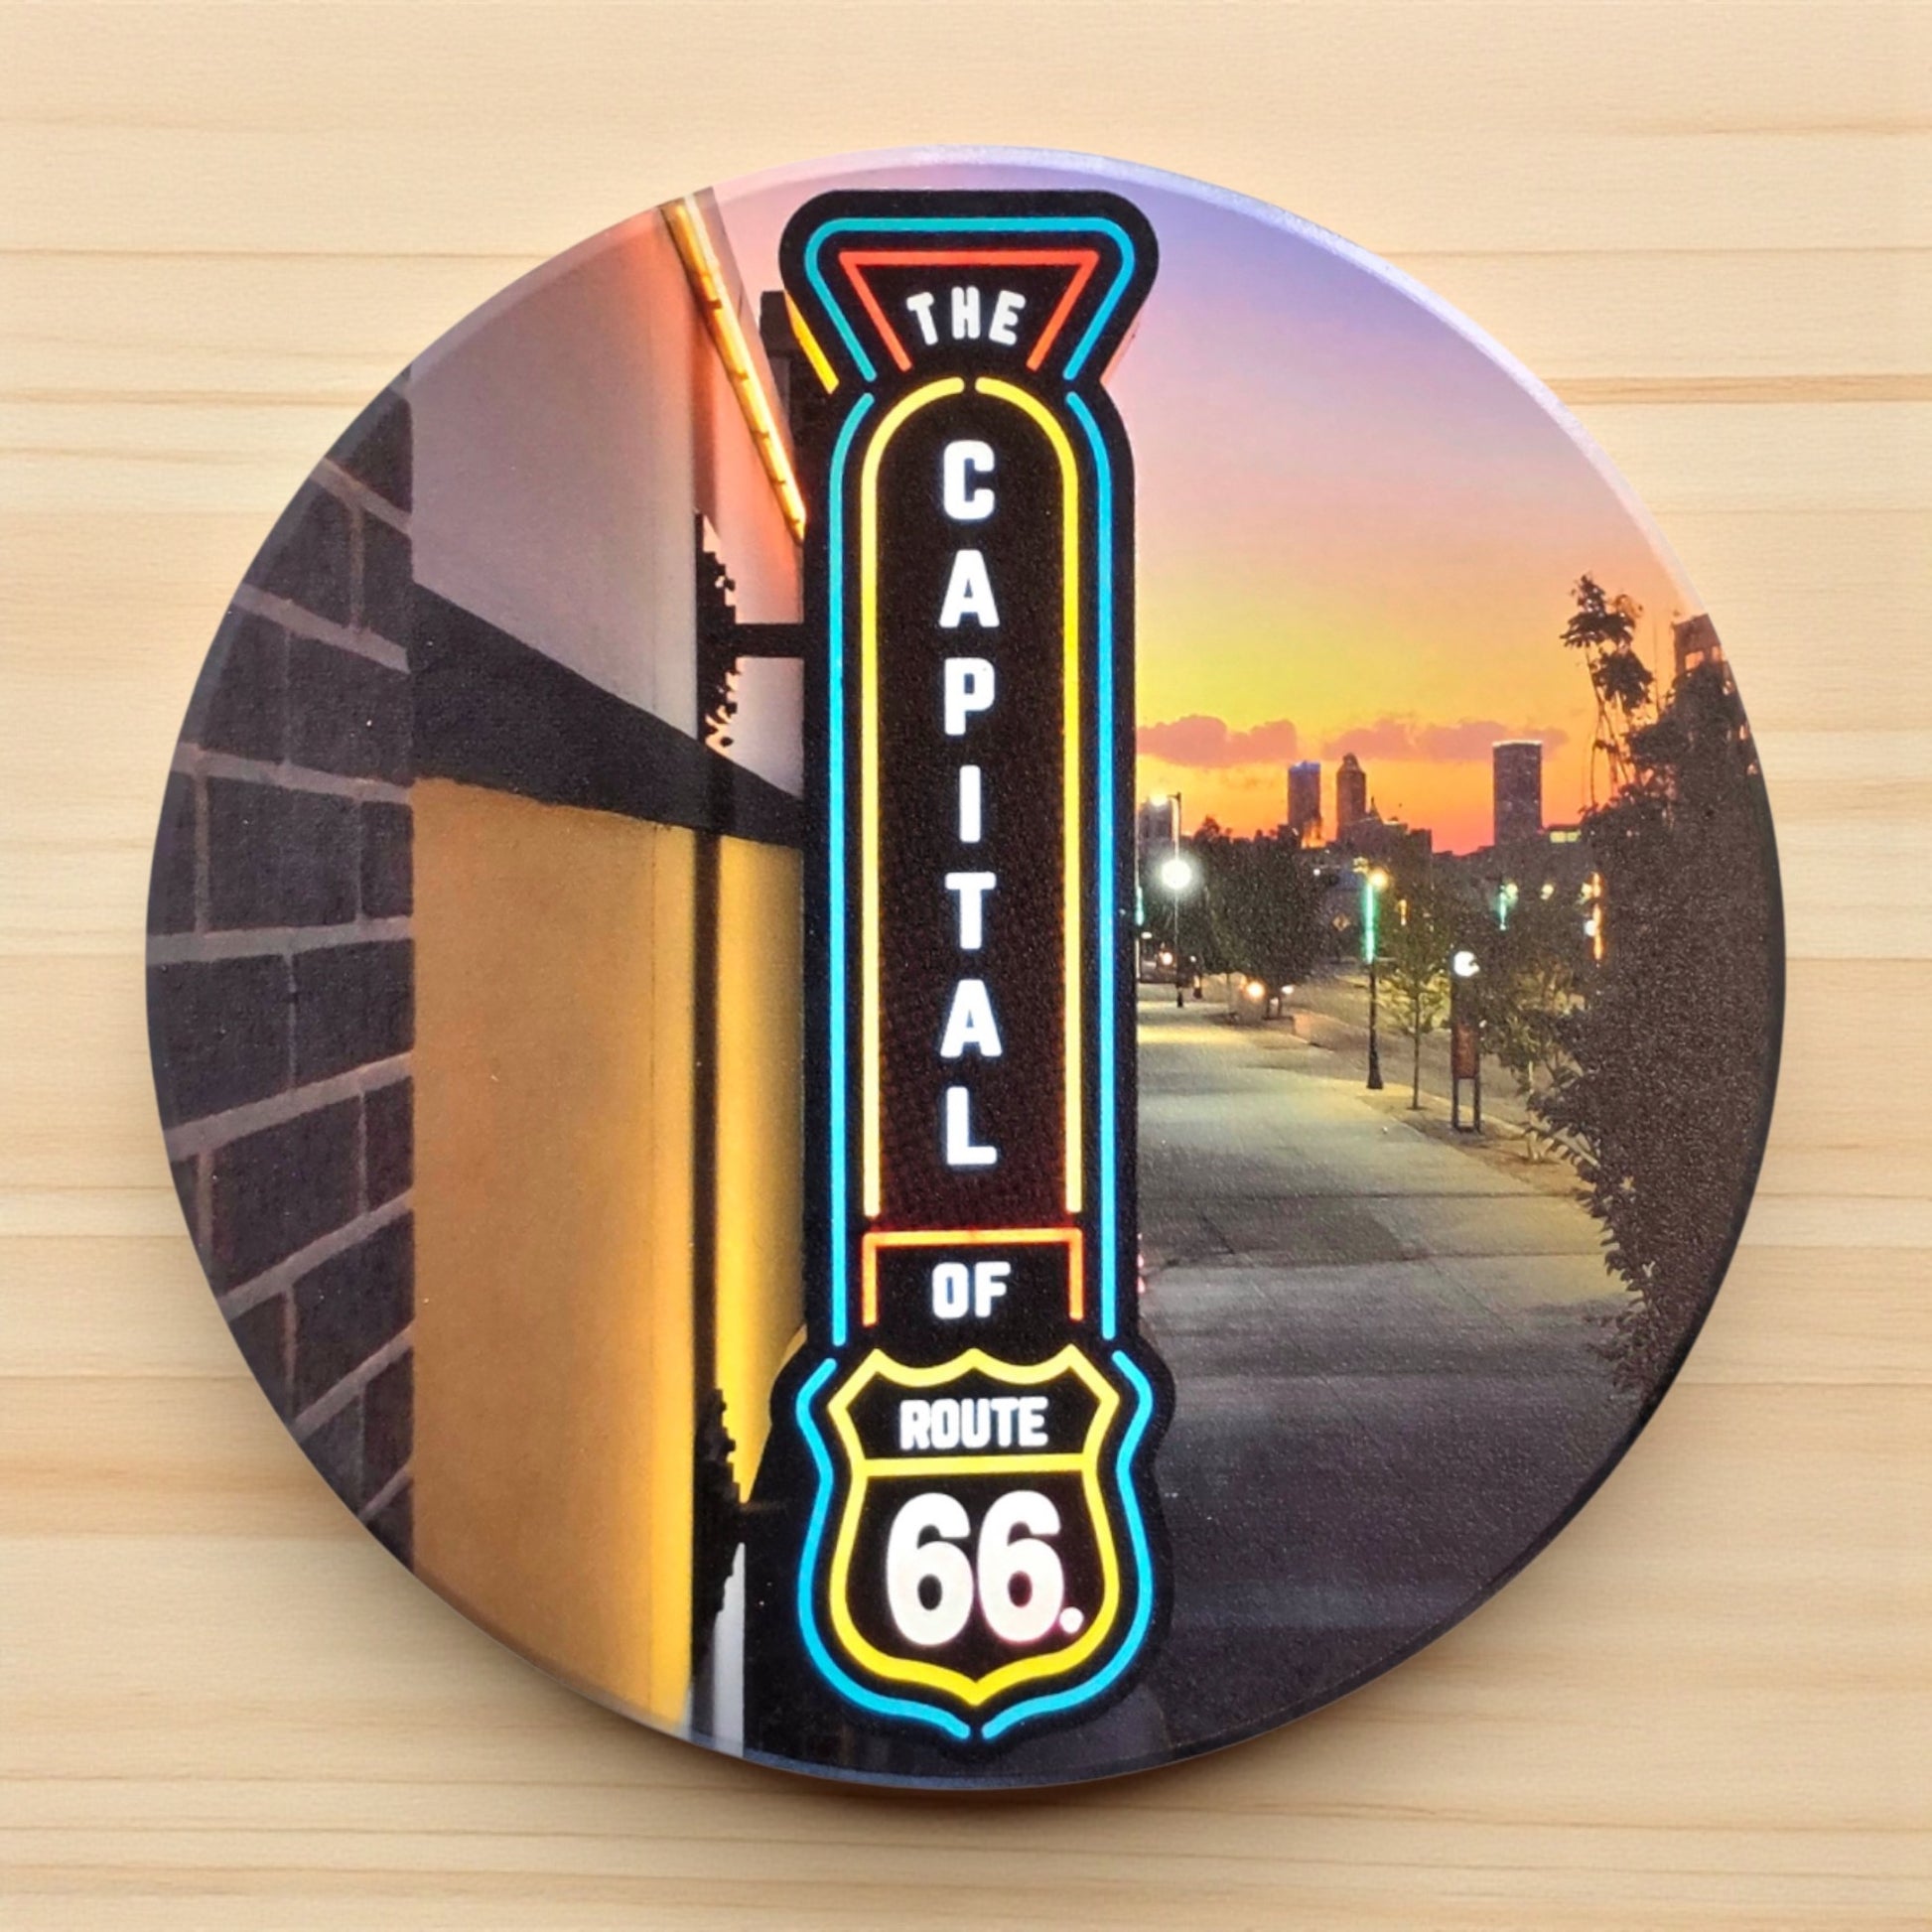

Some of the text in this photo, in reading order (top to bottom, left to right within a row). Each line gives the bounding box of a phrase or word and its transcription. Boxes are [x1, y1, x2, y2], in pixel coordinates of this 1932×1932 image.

[905, 285, 1027, 346] THE
[938, 438, 1003, 1167] CAPITAL
[931, 1261, 1012, 1319] OF
[899, 1395, 1049, 1450] ROUTE
